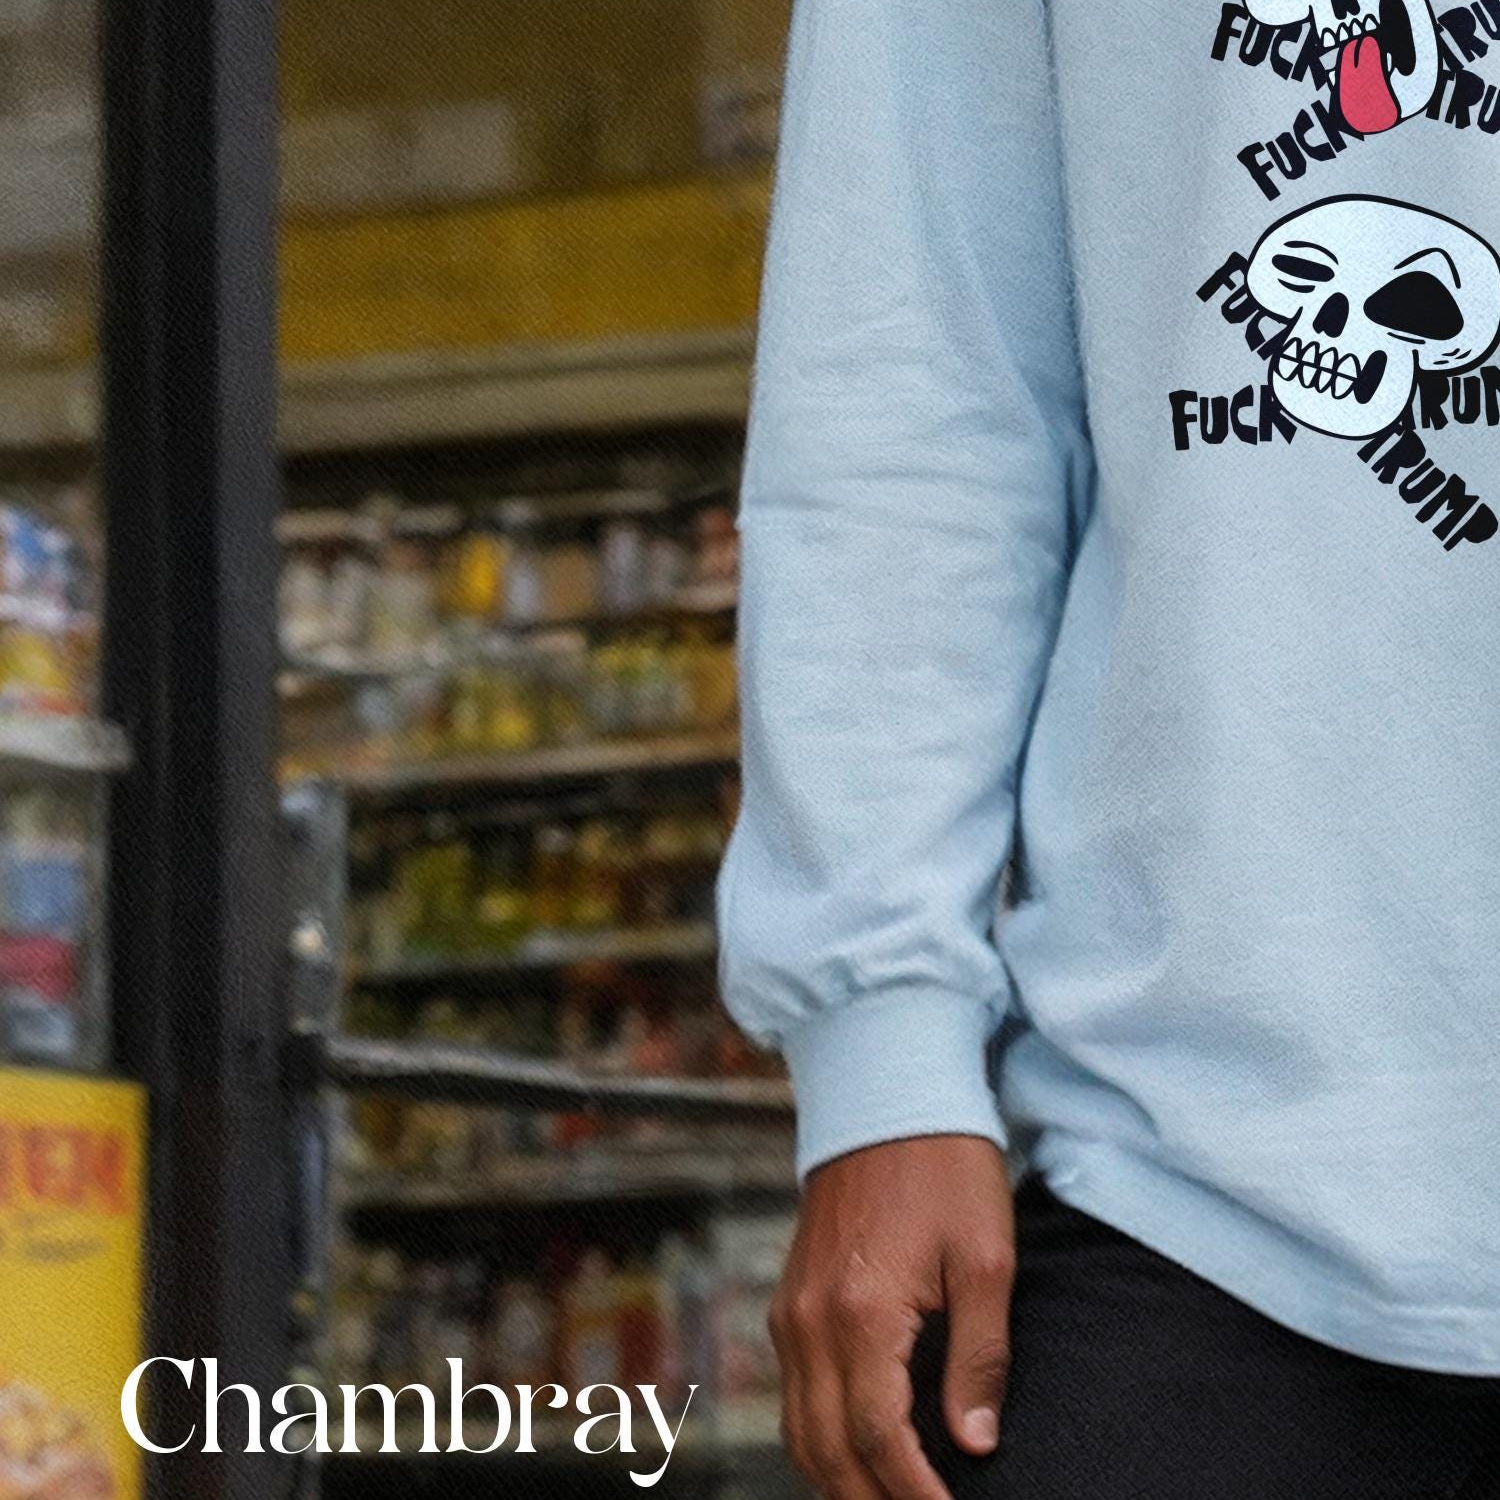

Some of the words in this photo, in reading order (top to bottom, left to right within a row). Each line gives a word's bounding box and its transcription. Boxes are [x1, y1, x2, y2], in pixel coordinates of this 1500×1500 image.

[1211, 3, 1335, 91] FUCK
[1237, 100, 1364, 201] FUCK
[1169, 384, 1297, 451] FUCK
[1357, 420, 1499, 552] TRUMP
